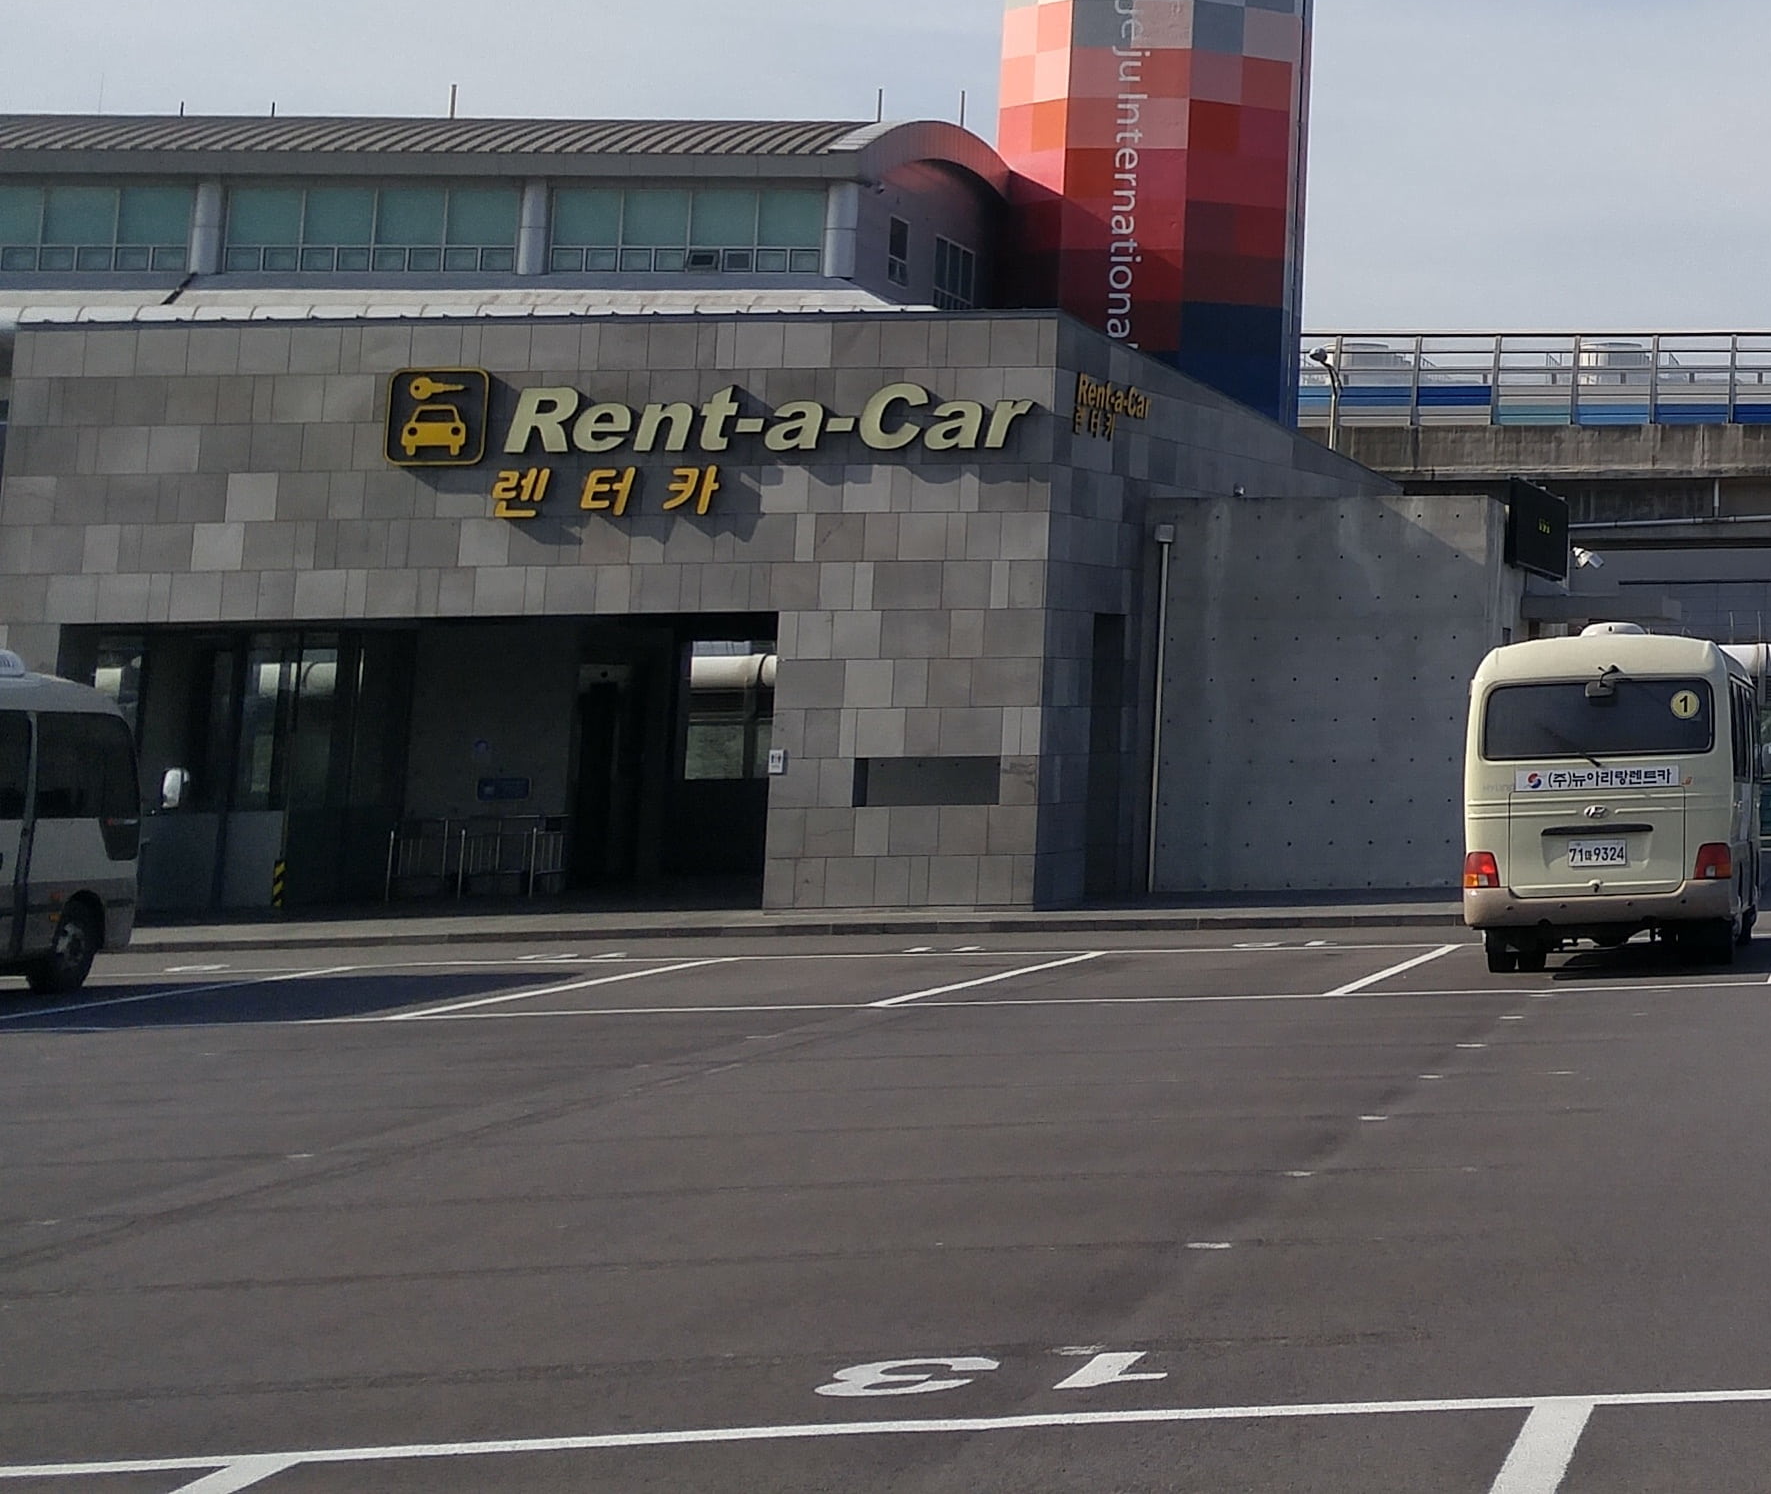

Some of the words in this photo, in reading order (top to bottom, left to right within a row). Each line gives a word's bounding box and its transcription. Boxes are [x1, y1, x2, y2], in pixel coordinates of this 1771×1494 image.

[503, 381, 1034, 455] Rent-a-Car
[1077, 373, 1151, 419] Rent-a-Car
[1679, 696, 1689, 713] 1
[1547, 768, 1672, 788] (주)뉴아리랑렌트카
[815, 1349, 1168, 1397] 13
